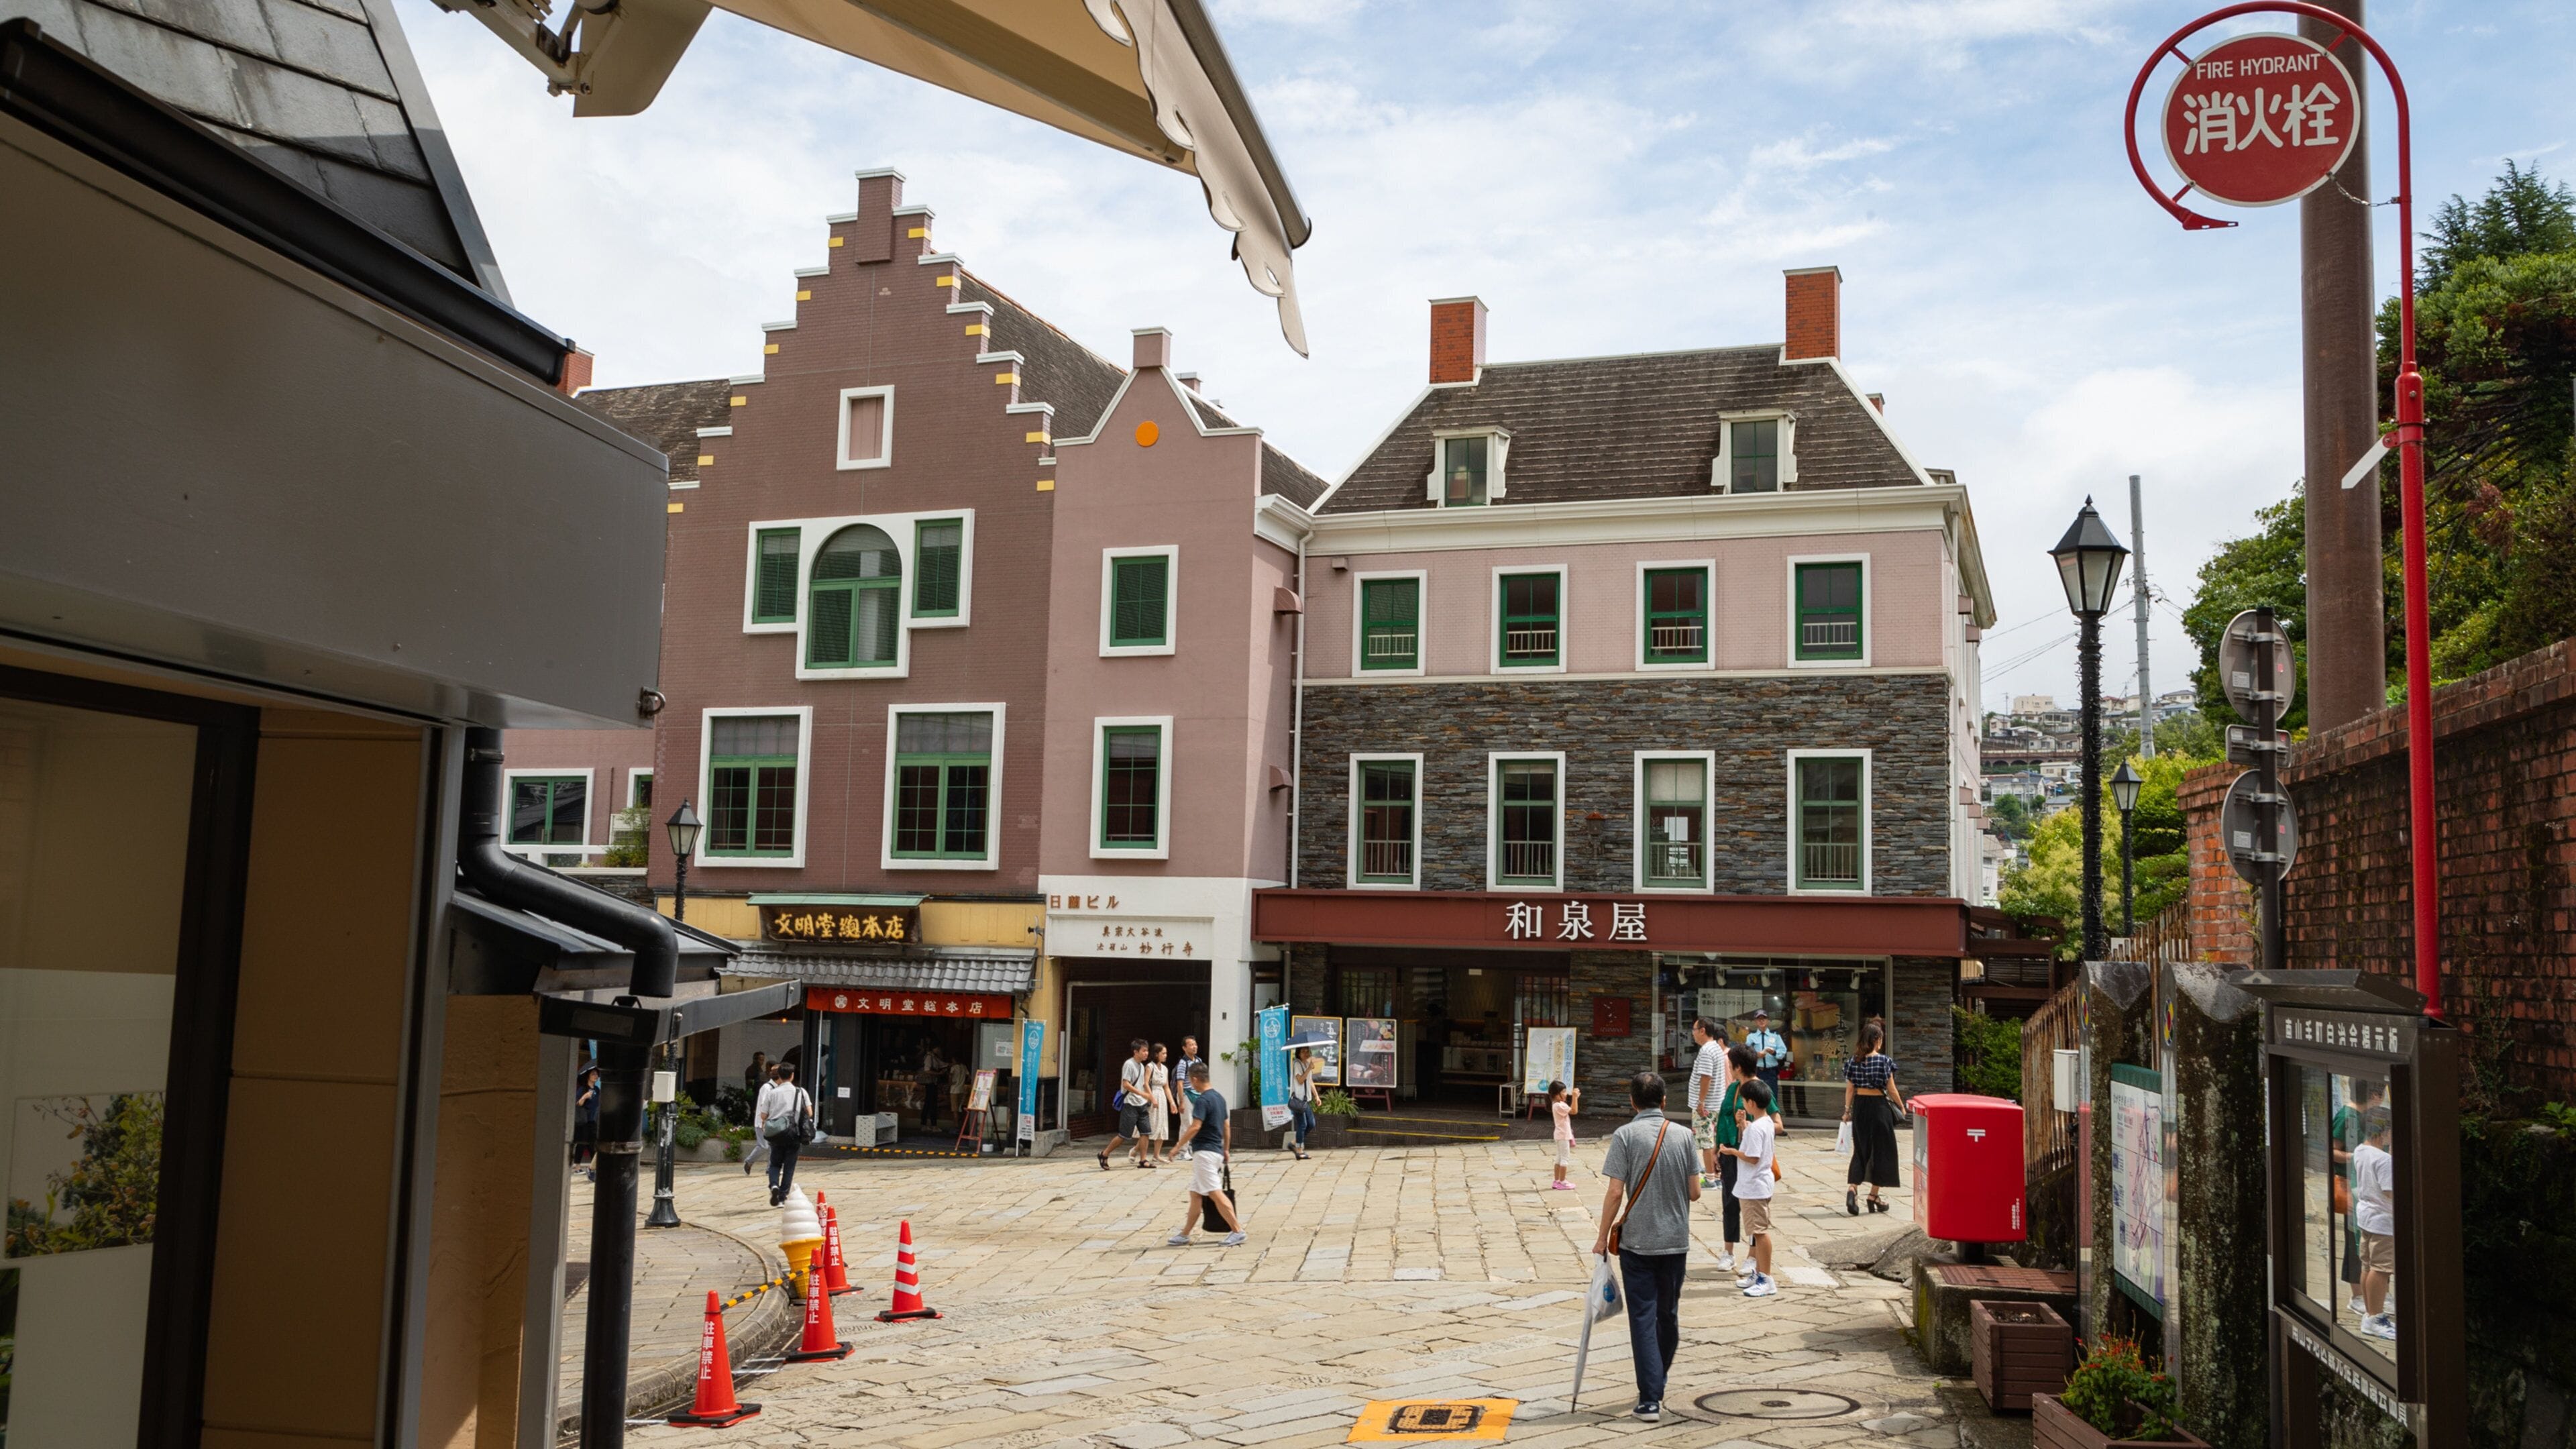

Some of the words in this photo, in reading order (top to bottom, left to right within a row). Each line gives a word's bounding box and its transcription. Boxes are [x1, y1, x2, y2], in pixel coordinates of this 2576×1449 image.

[2196, 60, 2234, 80] FIRE
[2240, 53, 2322, 76] HYDRANT
[2182, 82, 2341, 156] 消火栓
[1504, 900, 1648, 941] 和泉屋
[1139, 941, 1193, 957] 妙行寺
[857, 998, 982, 1014] 文明堂総本店
[2285, 1018, 2398, 1054] 南山手町自治会掲示板
[829, 1226, 840, 1267] 駐車禁止
[808, 1274, 820, 1325] 駐車禁止
[700, 1320, 715, 1381] 駐車禁止
